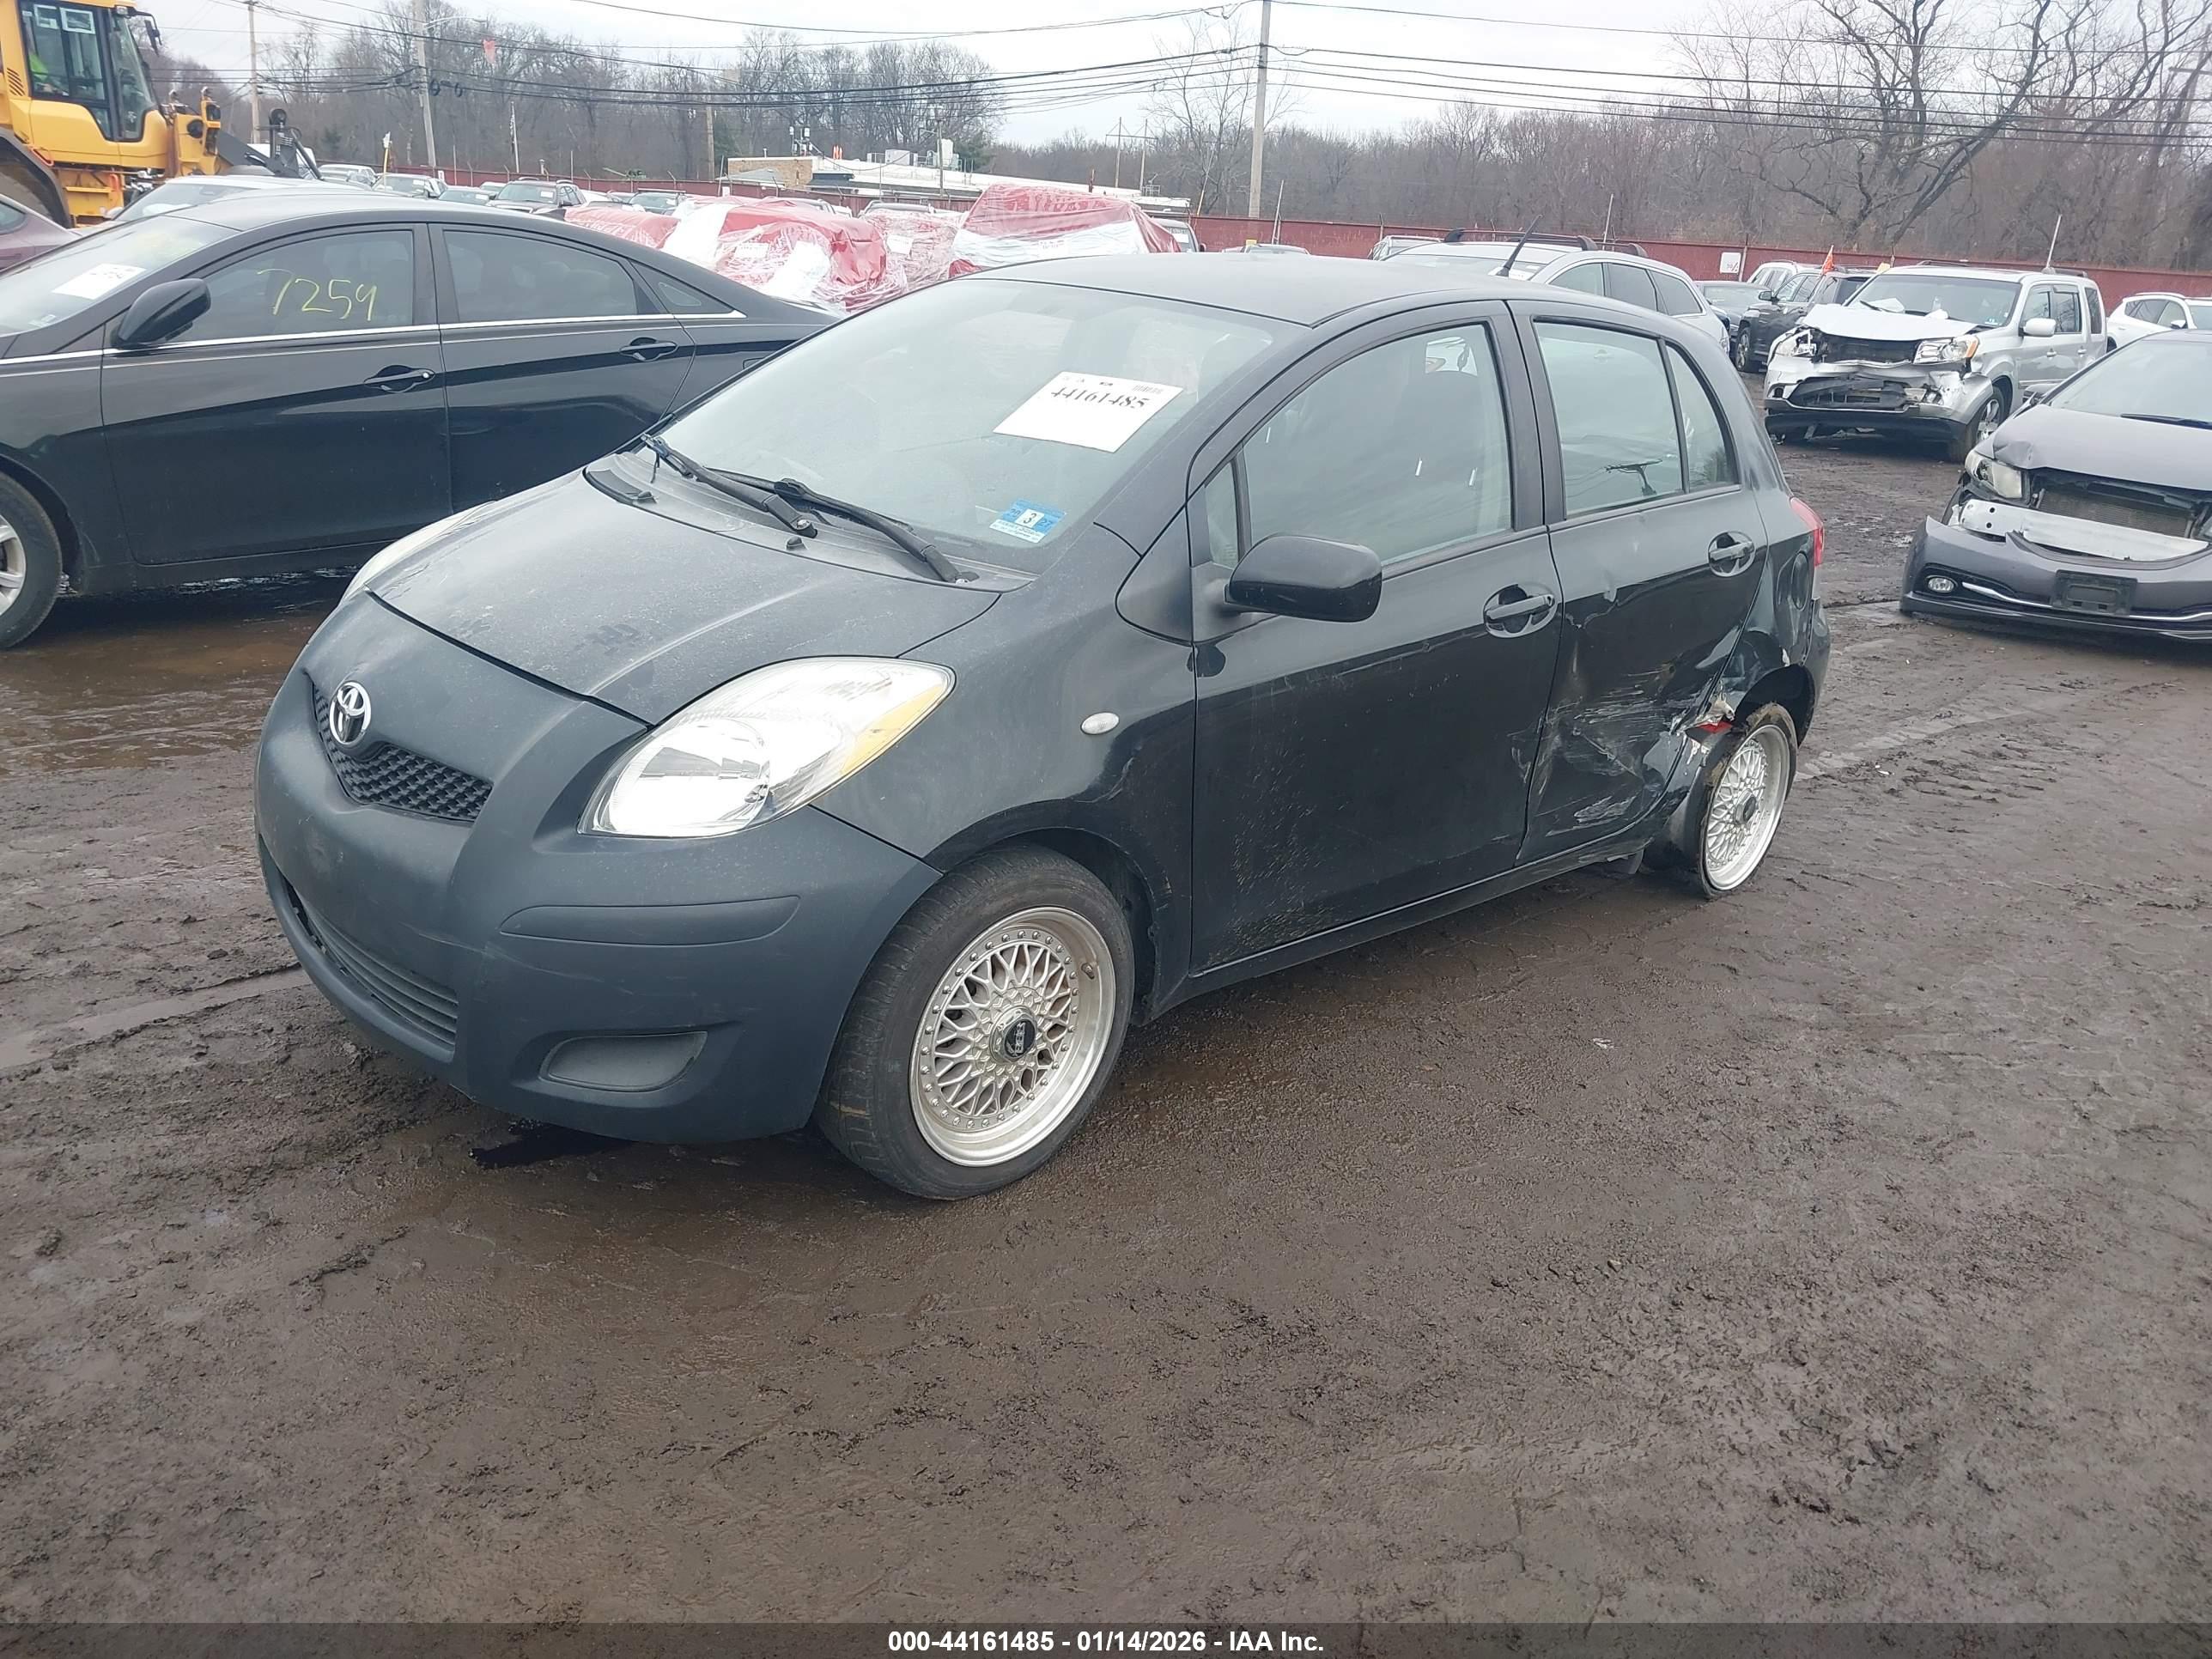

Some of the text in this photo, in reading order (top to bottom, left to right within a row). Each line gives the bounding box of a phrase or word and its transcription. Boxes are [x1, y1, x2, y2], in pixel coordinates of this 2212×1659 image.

[257, 268, 377, 321] 7259
[1051, 386, 1150, 409] 44161485
[1023, 513, 1037, 524] 3
